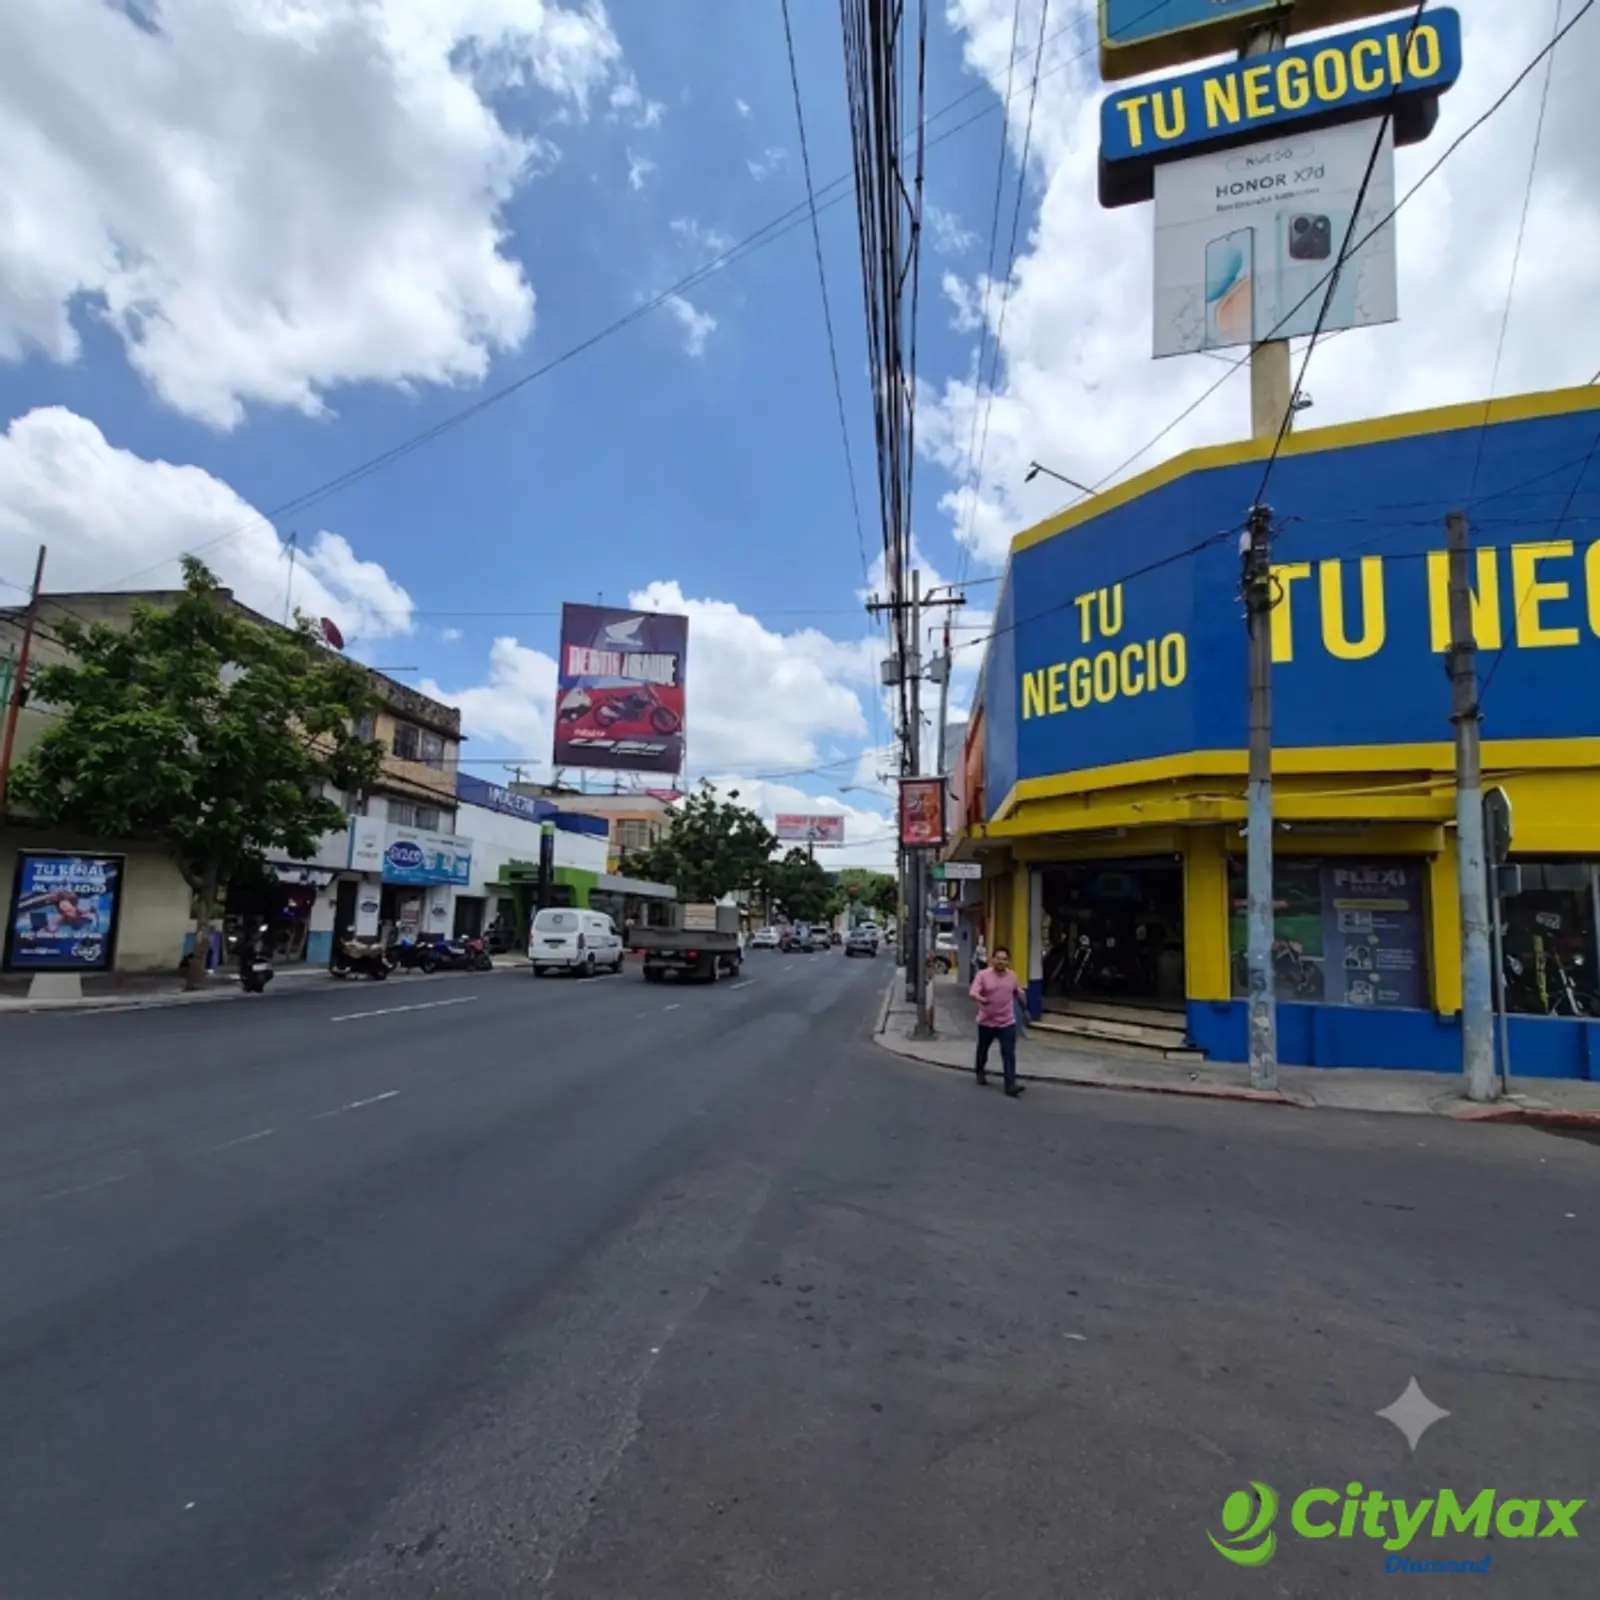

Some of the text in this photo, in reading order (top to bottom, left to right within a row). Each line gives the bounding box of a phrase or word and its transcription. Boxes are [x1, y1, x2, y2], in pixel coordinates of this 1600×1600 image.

[1116, 24, 1442, 148] TU NEGOCIO
[1216, 173, 1287, 198] HONOR
[1074, 582, 1123, 644] TU
[1269, 538, 1600, 663] TU NE
[1022, 631, 1187, 720] NEGOCIO
